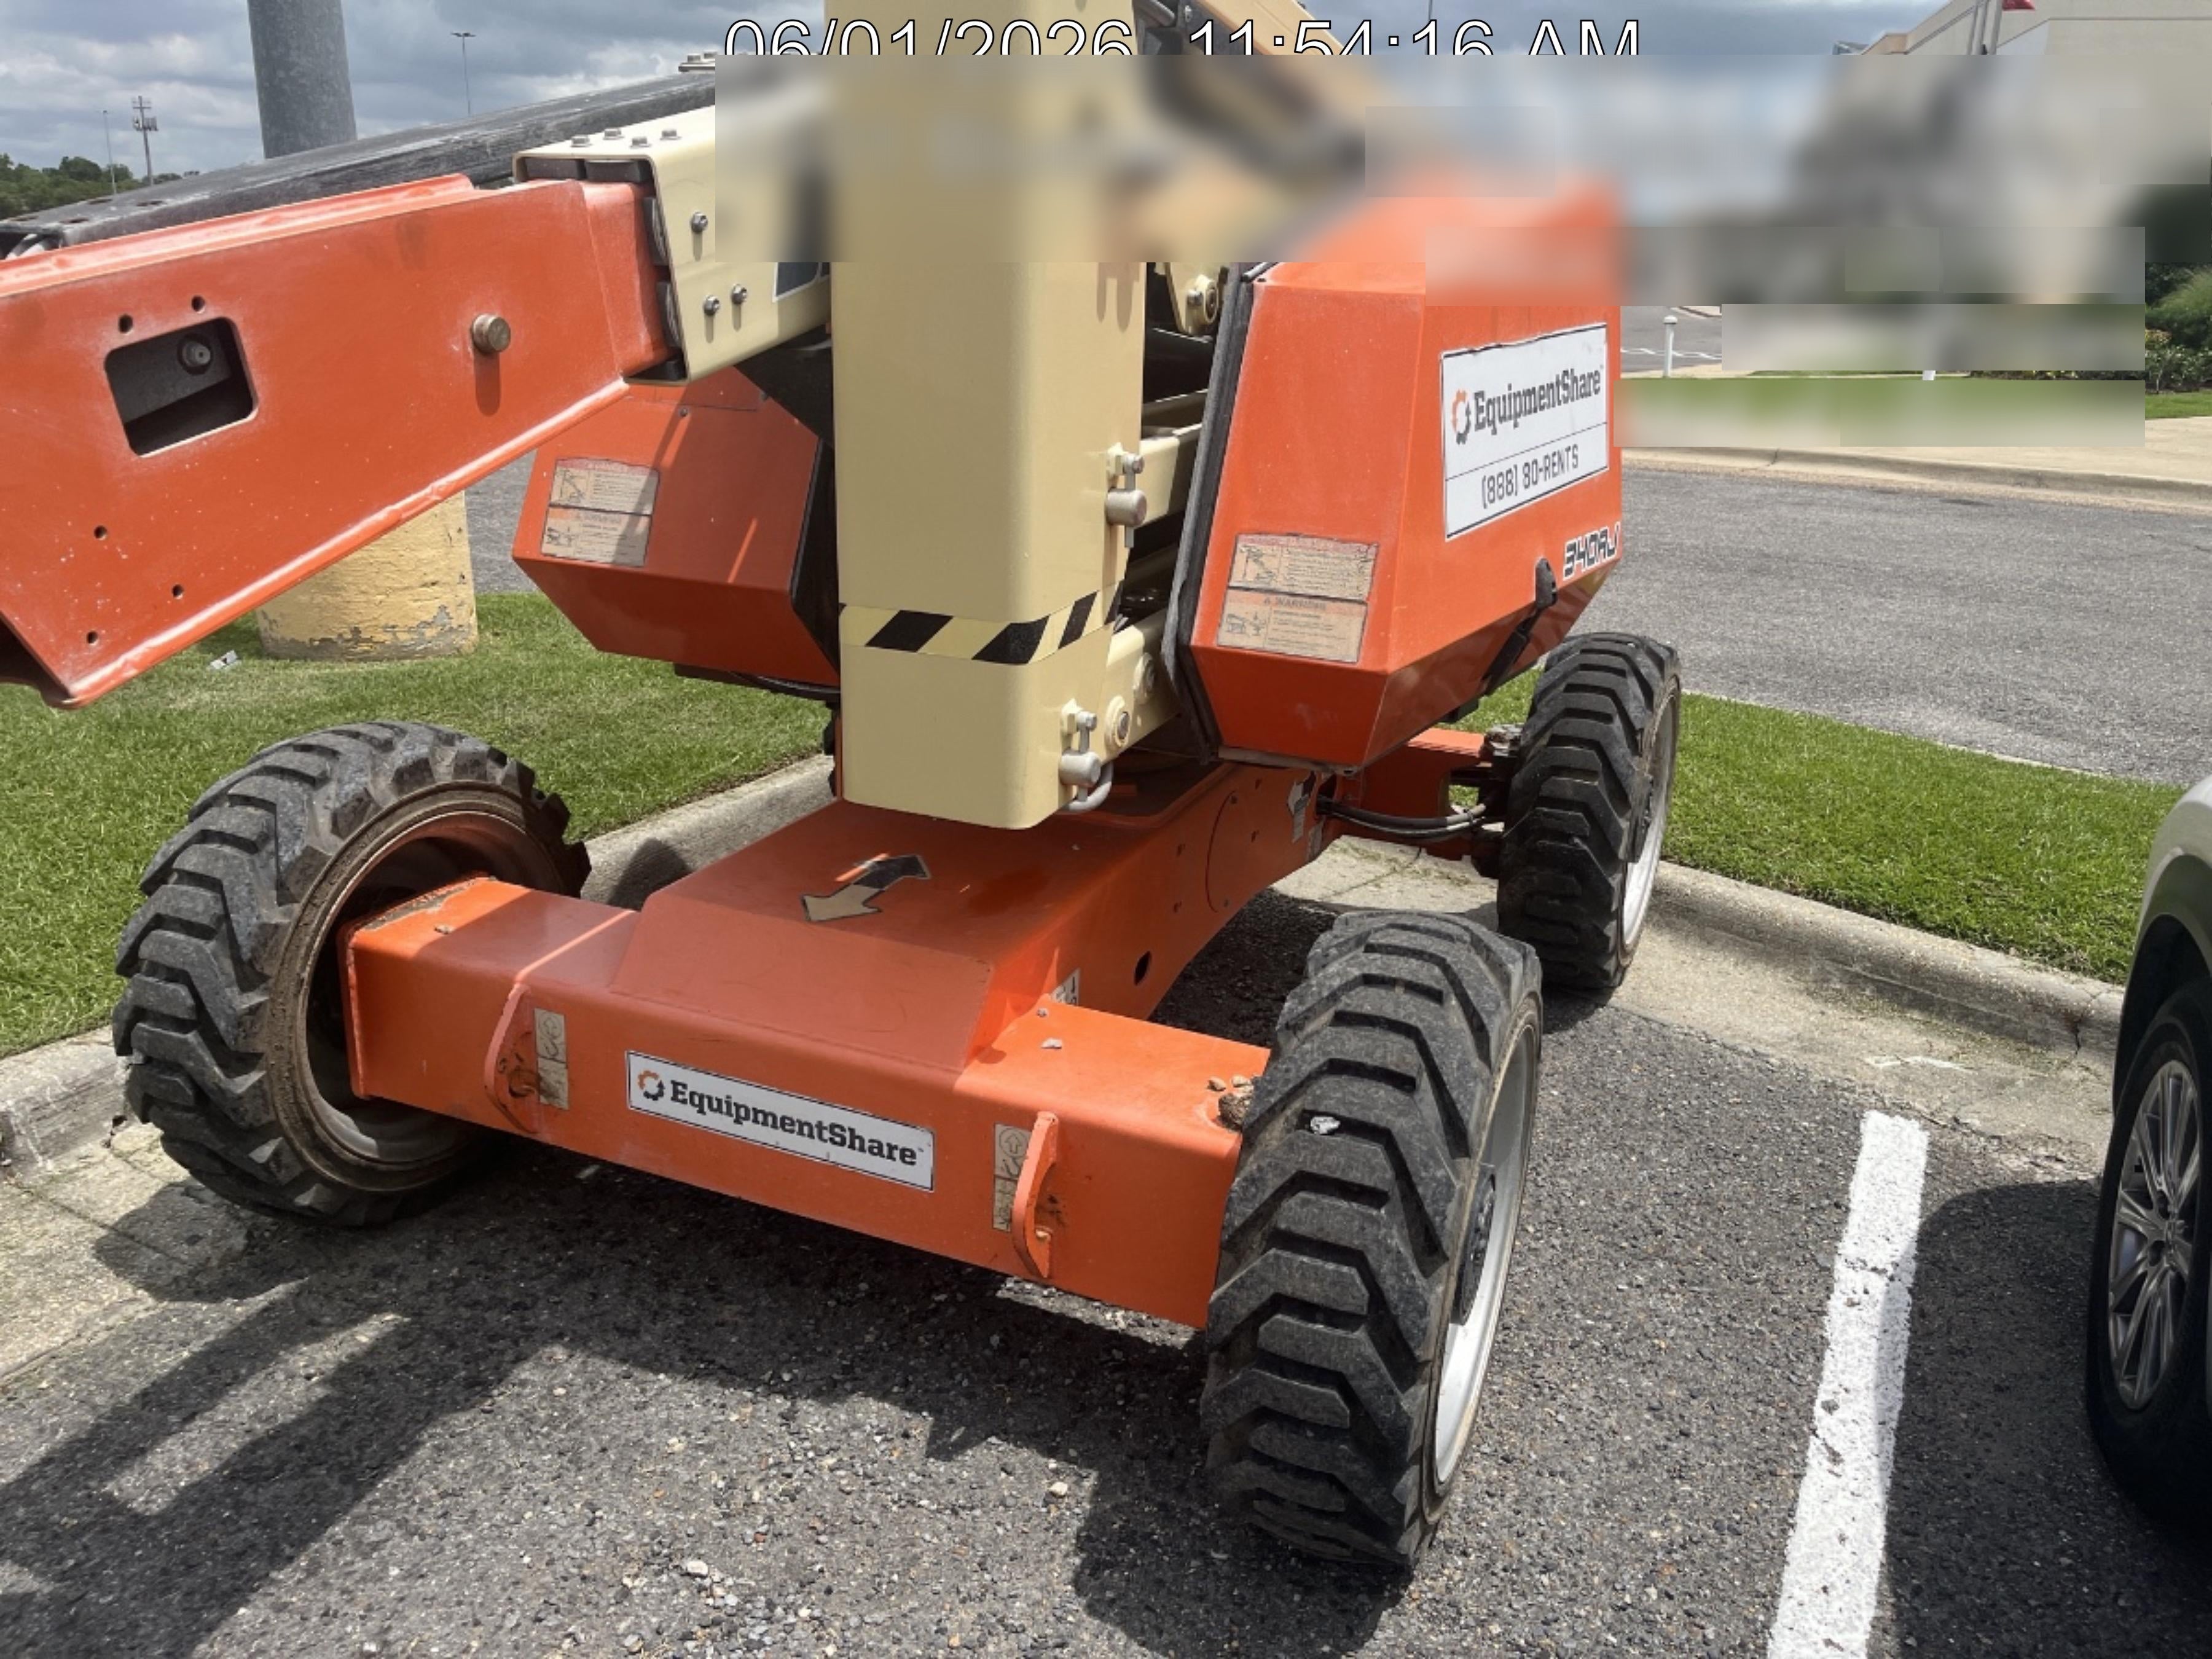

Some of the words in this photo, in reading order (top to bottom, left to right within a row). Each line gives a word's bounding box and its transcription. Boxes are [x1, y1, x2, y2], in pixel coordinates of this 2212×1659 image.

[1474, 369, 1601, 435] EquipmentShare
[1481, 464, 1519, 509] (888)
[1523, 444, 1579, 490] 80-RENTS
[670, 1080, 917, 1166] EquipmentShare
